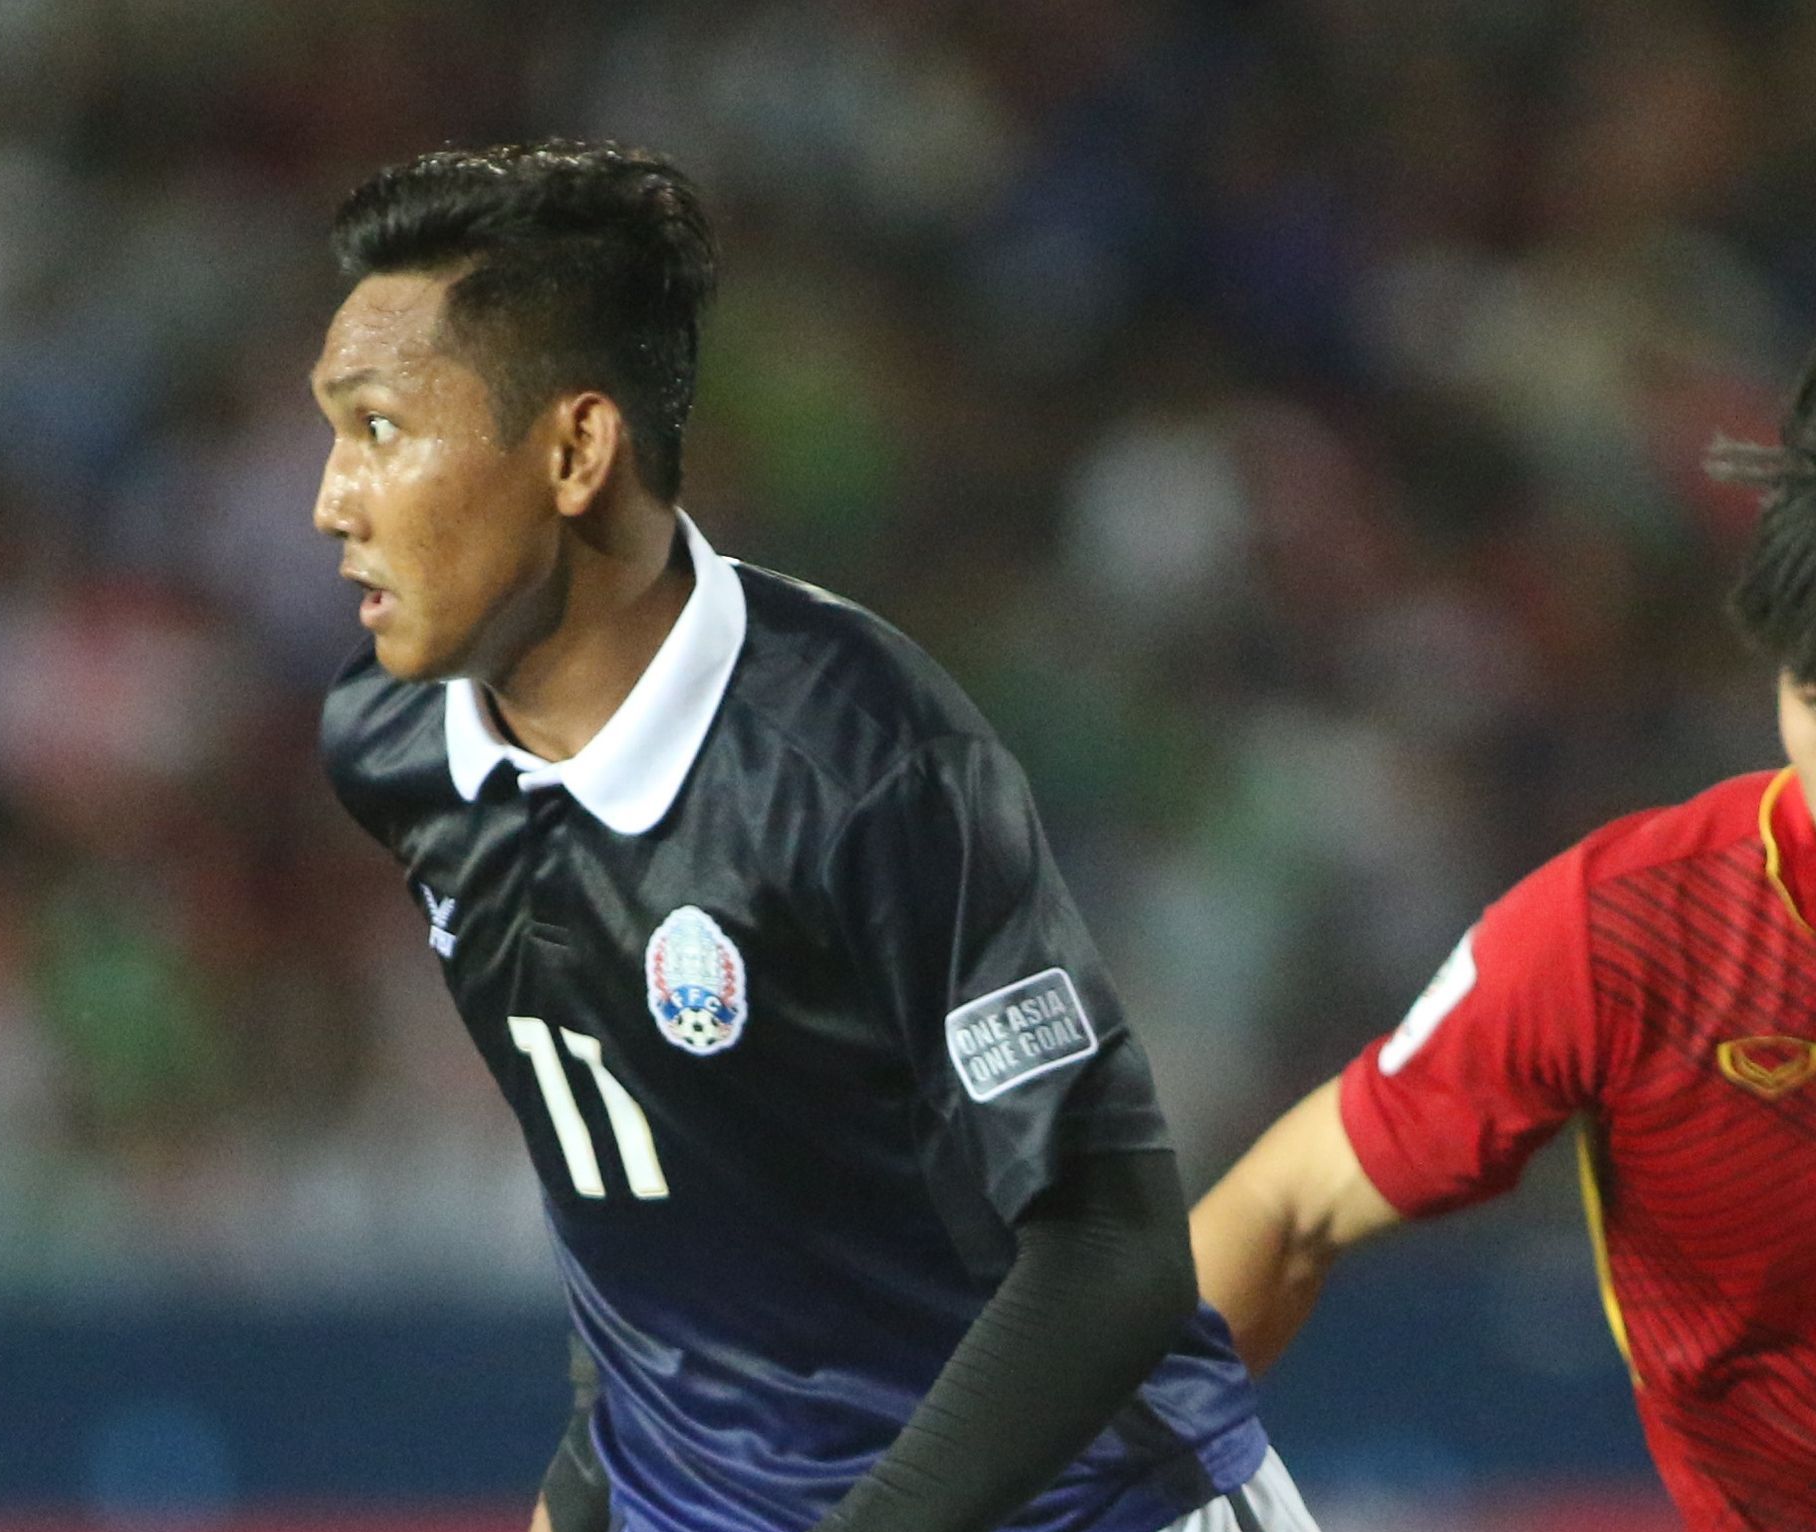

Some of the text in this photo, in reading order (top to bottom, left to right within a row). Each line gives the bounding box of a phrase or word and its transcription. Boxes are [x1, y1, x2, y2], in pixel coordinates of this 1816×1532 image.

[955, 989, 1067, 1056] ONE ASIA
[969, 1016, 1083, 1083] ONE GOAL
[506, 1015, 671, 1199] 11
